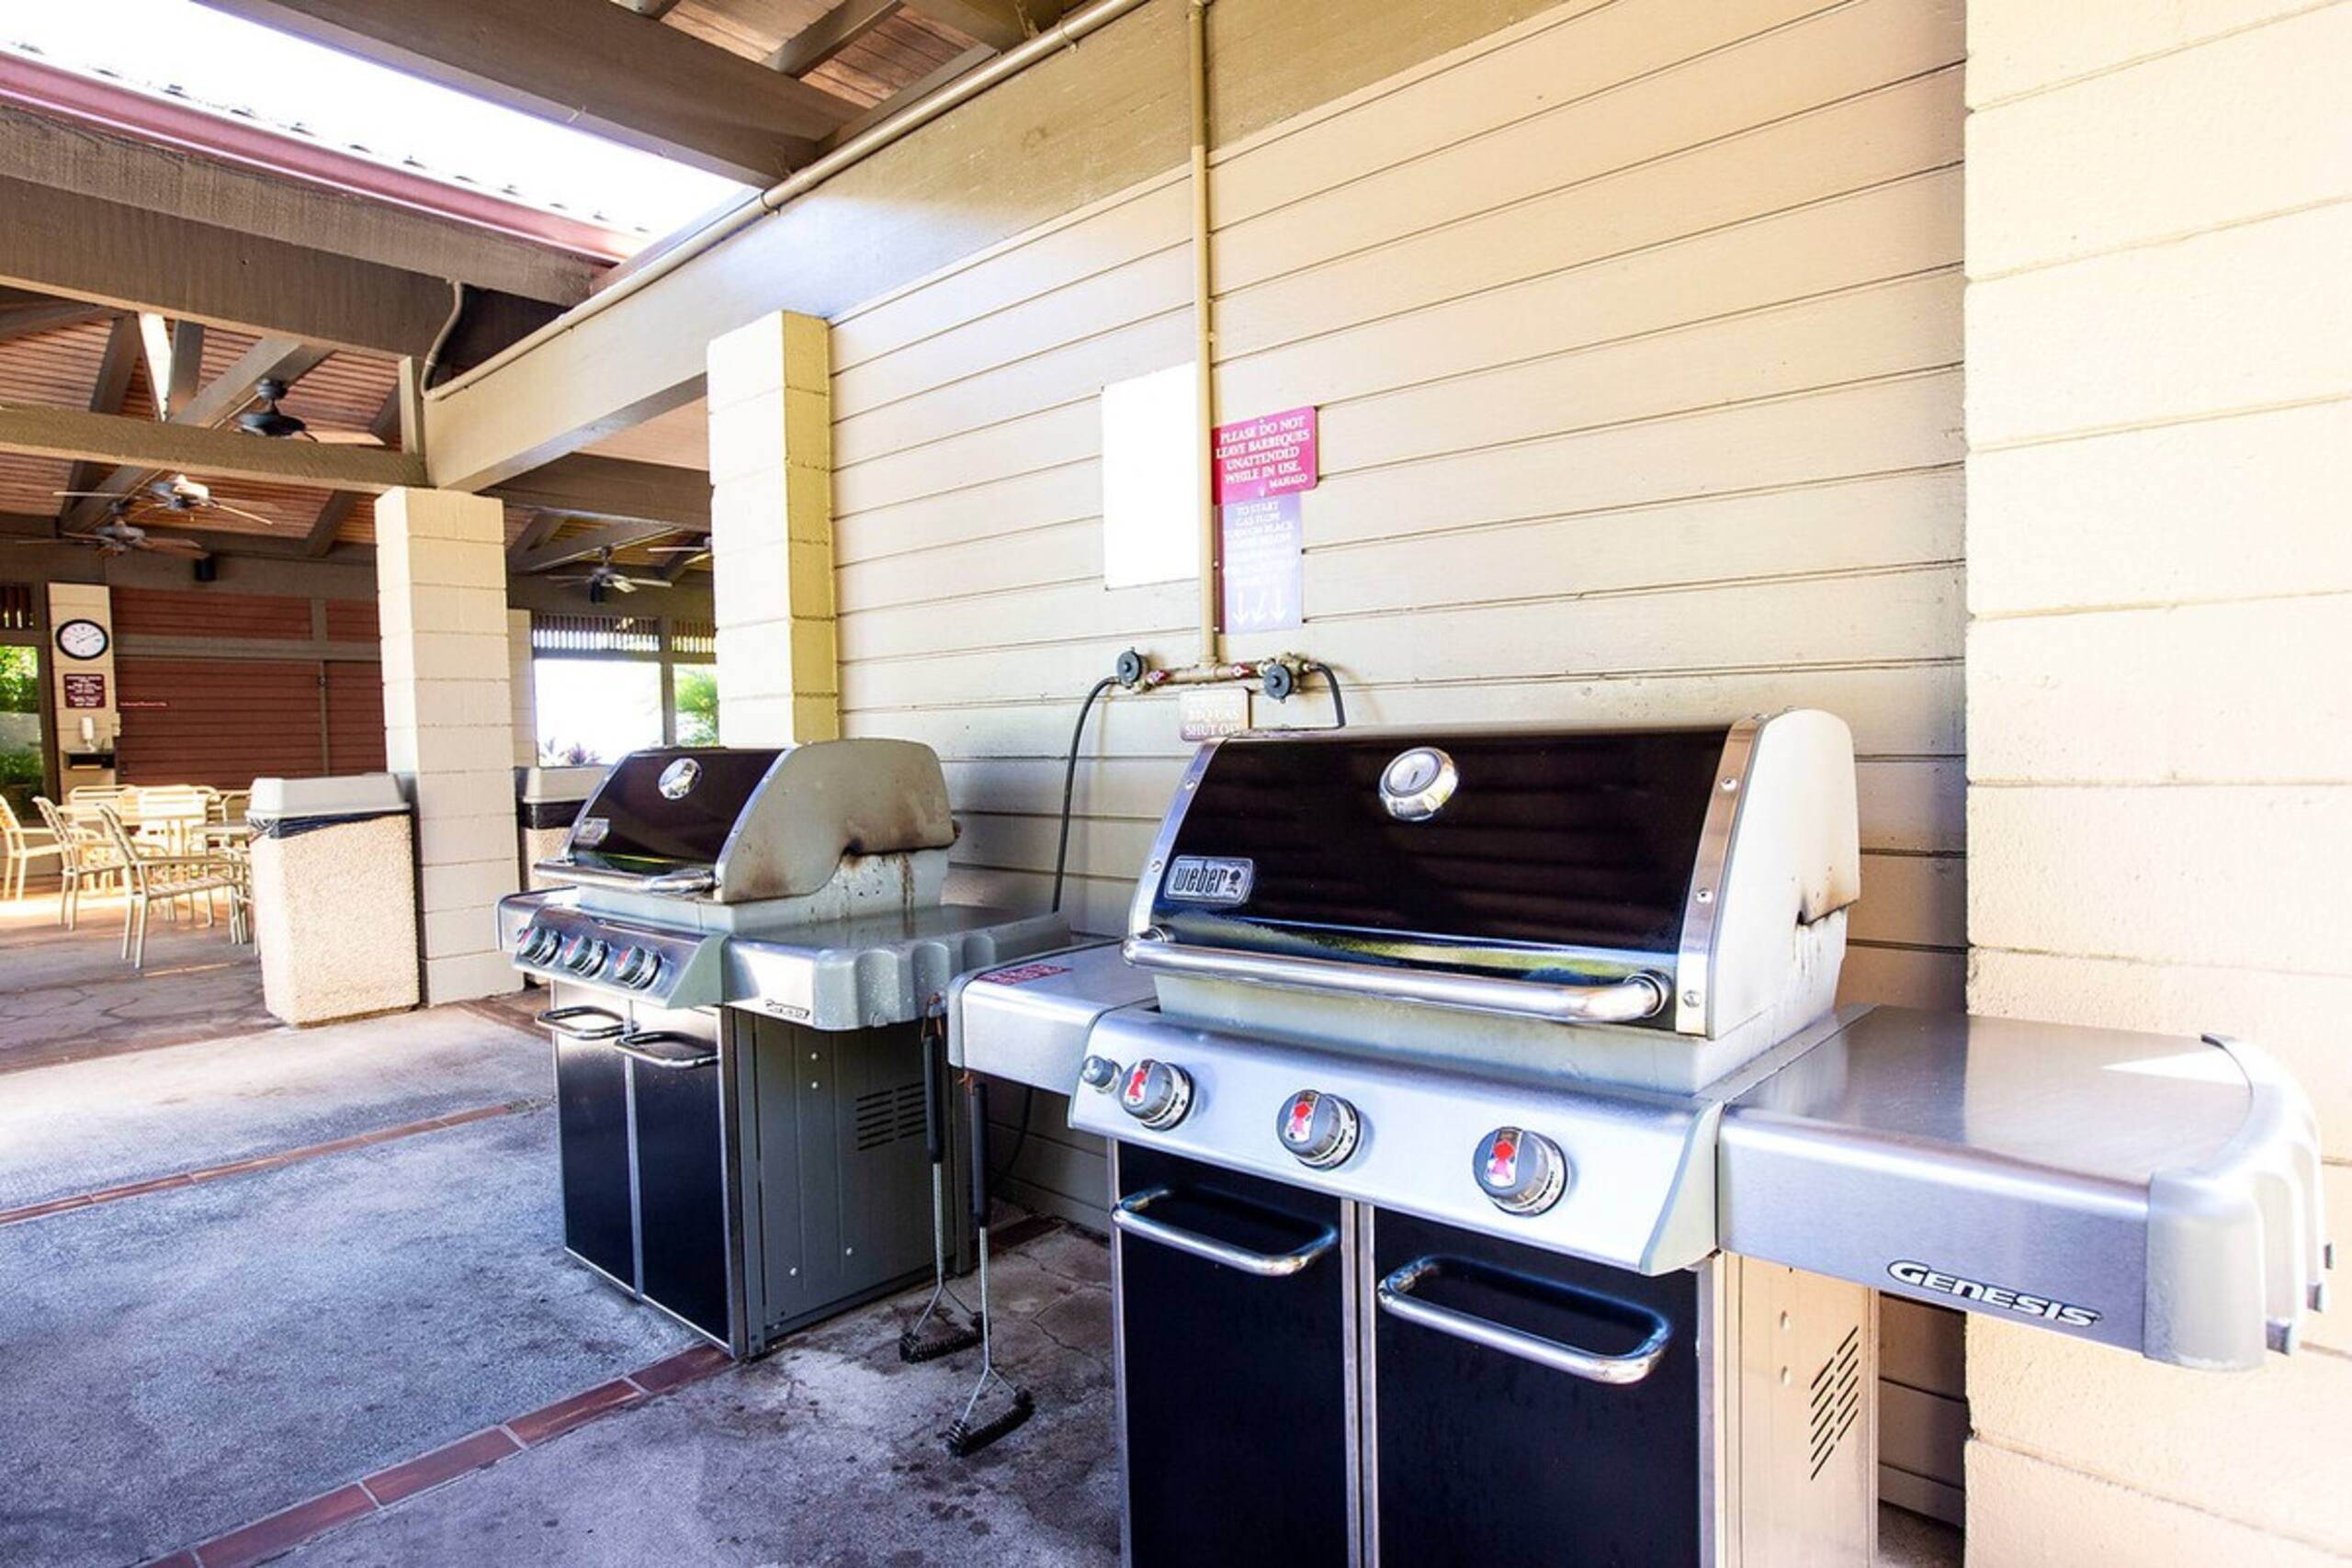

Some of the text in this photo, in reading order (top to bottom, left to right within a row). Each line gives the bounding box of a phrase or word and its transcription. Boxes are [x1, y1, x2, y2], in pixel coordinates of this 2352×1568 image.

[1220, 415, 1306, 445] PLEASE DO NOT
[1216, 443, 1247, 458] LEAVE
[1227, 446, 1299, 470] UNATTENDED
[1225, 468, 1260, 484] WHILE
[1262, 465, 1275, 478] IN
[1174, 868, 1228, 893] weber
[1887, 1259, 2100, 1326] GENESIS
